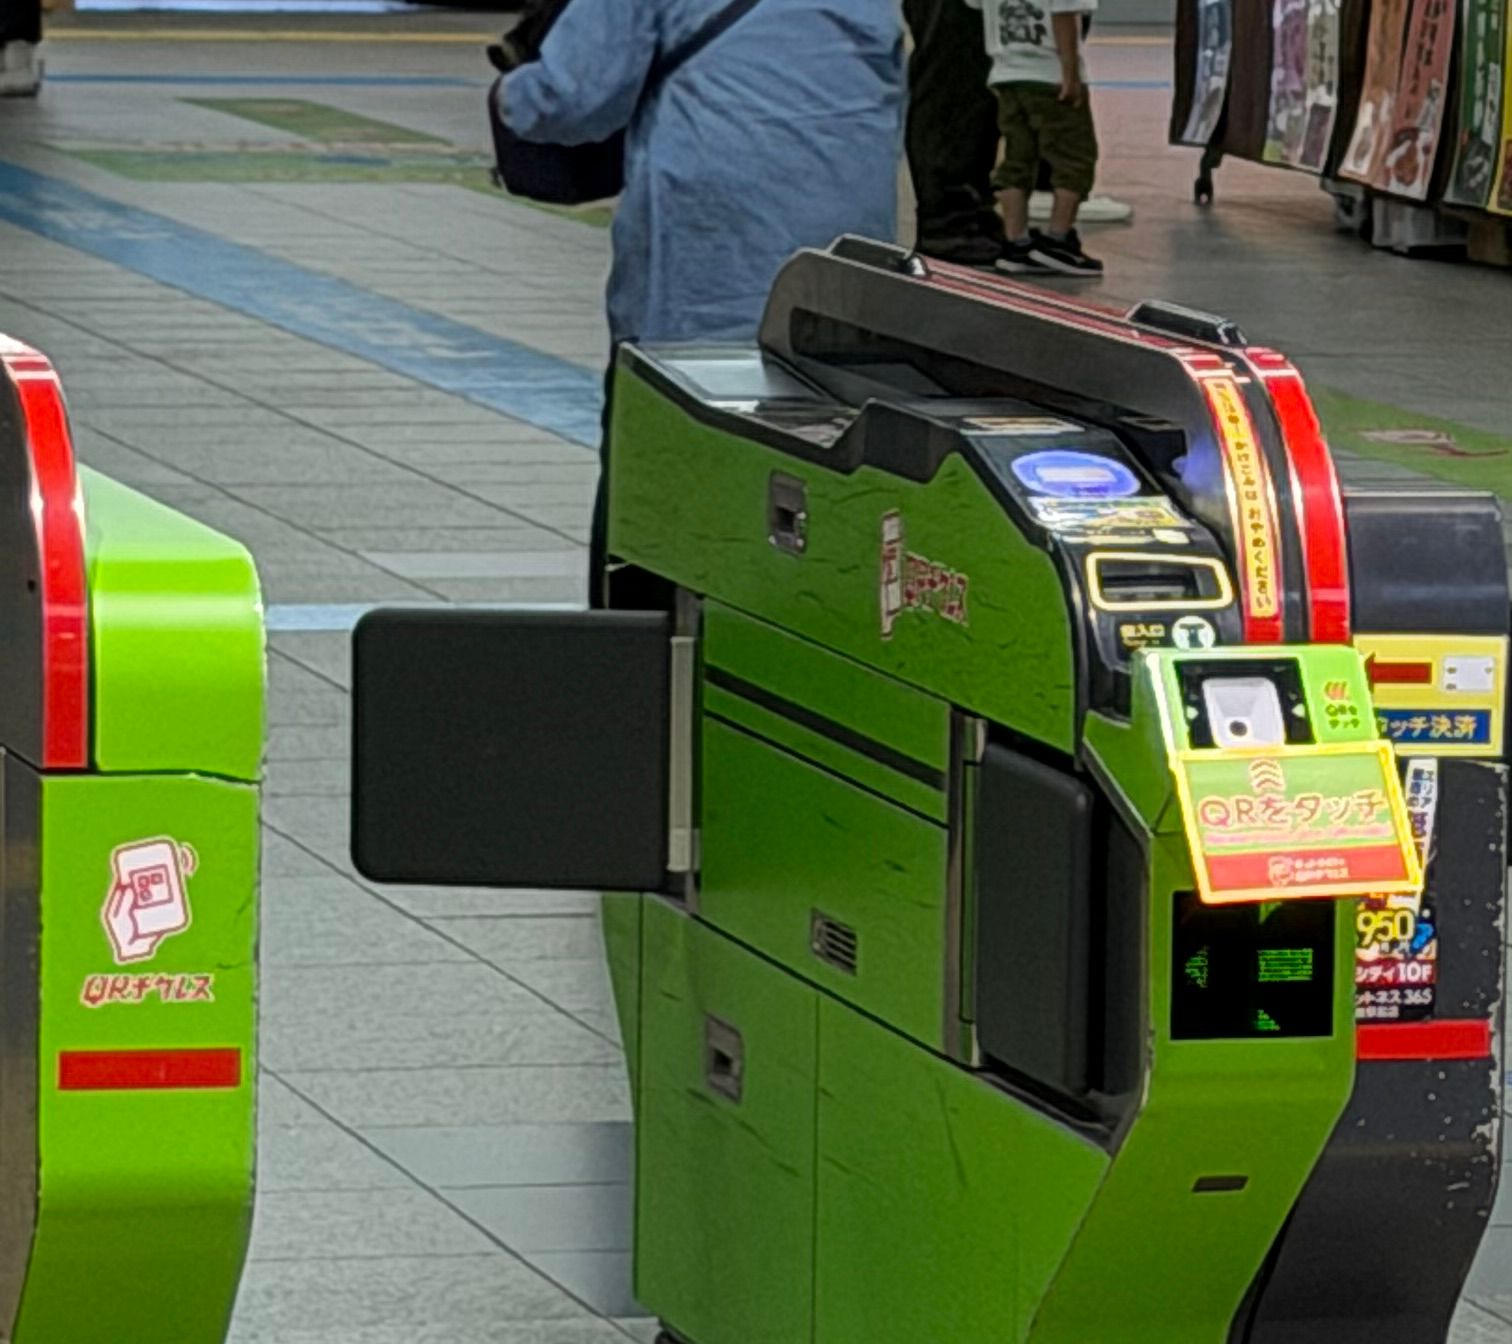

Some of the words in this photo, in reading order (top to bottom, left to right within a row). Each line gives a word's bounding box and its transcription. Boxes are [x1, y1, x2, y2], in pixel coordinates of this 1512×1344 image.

[1200, 791, 1385, 827] QRをタッチ
[1356, 907, 1415, 947] 950
[82, 974, 213, 1007] QRチケレス
